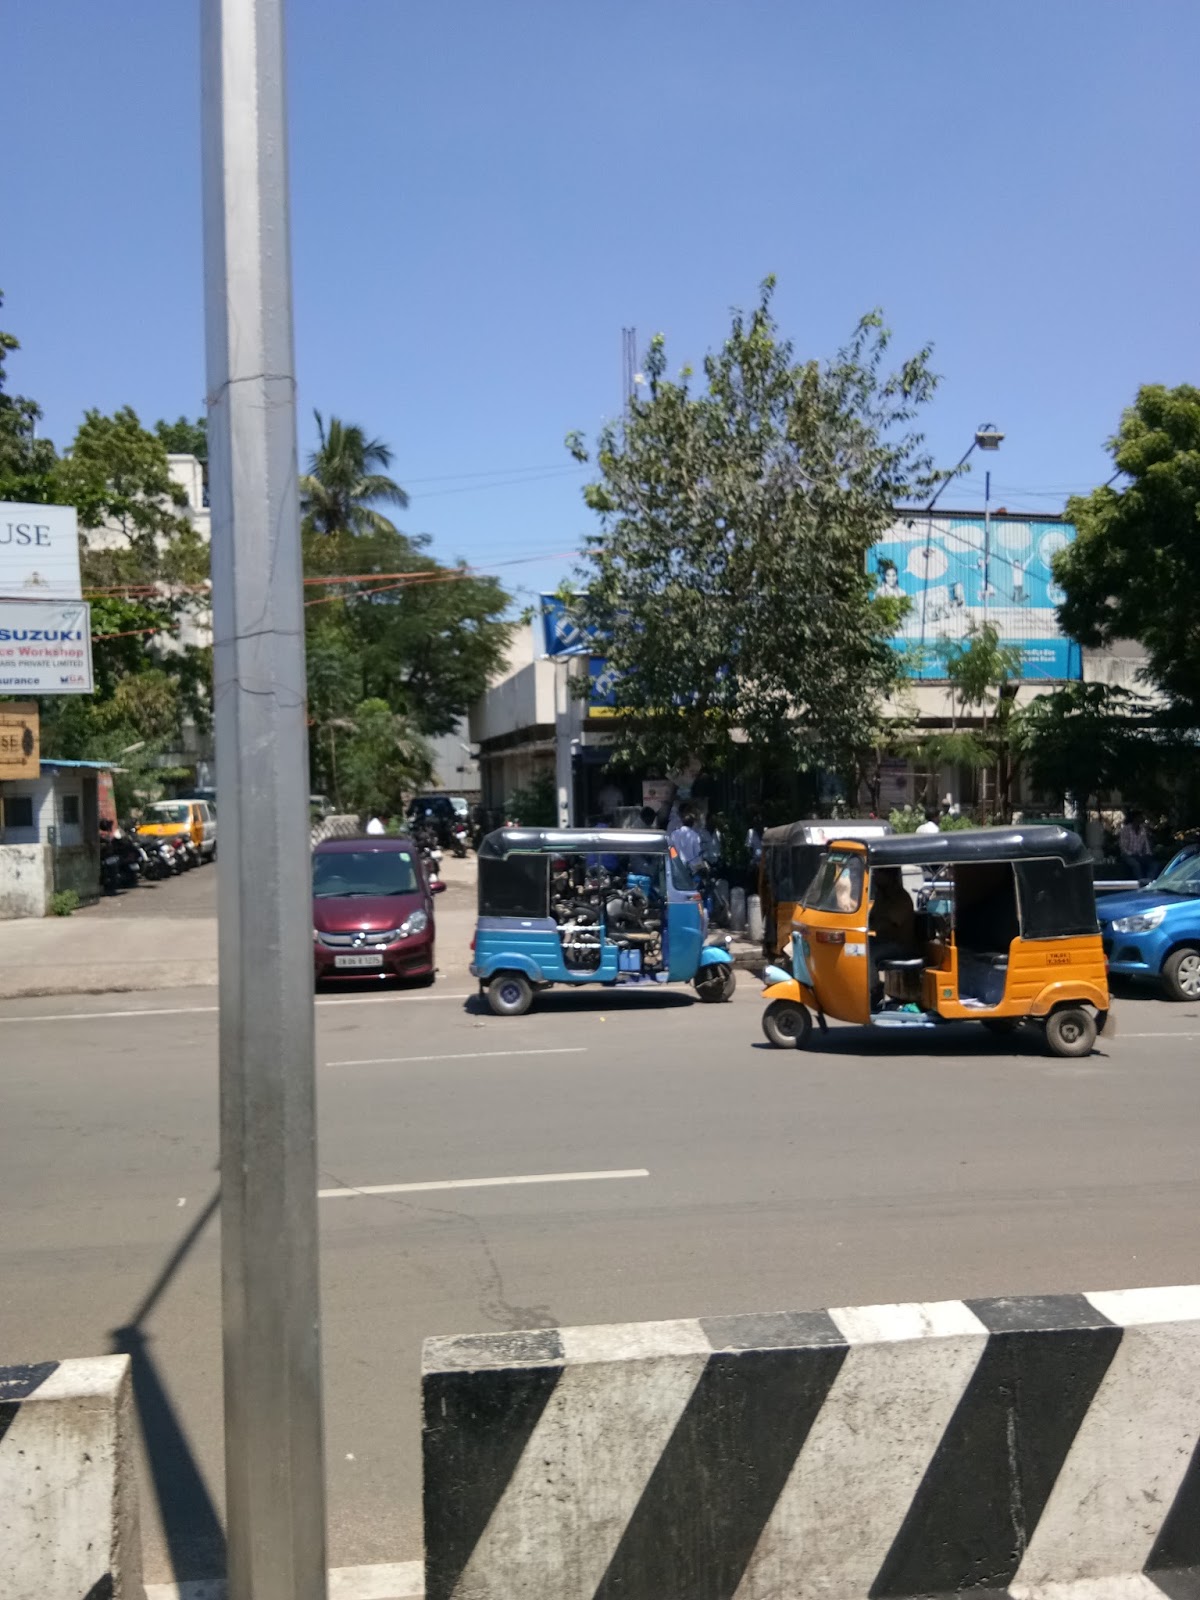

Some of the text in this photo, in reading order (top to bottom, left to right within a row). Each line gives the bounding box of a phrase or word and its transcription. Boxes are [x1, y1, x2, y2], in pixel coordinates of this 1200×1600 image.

[0, 629, 82, 641] SUZUKI
[19, 646, 83, 658] Workshop
[18, 660, 50, 668] PRIVATE
[53, 660, 84, 668] LIMITED
